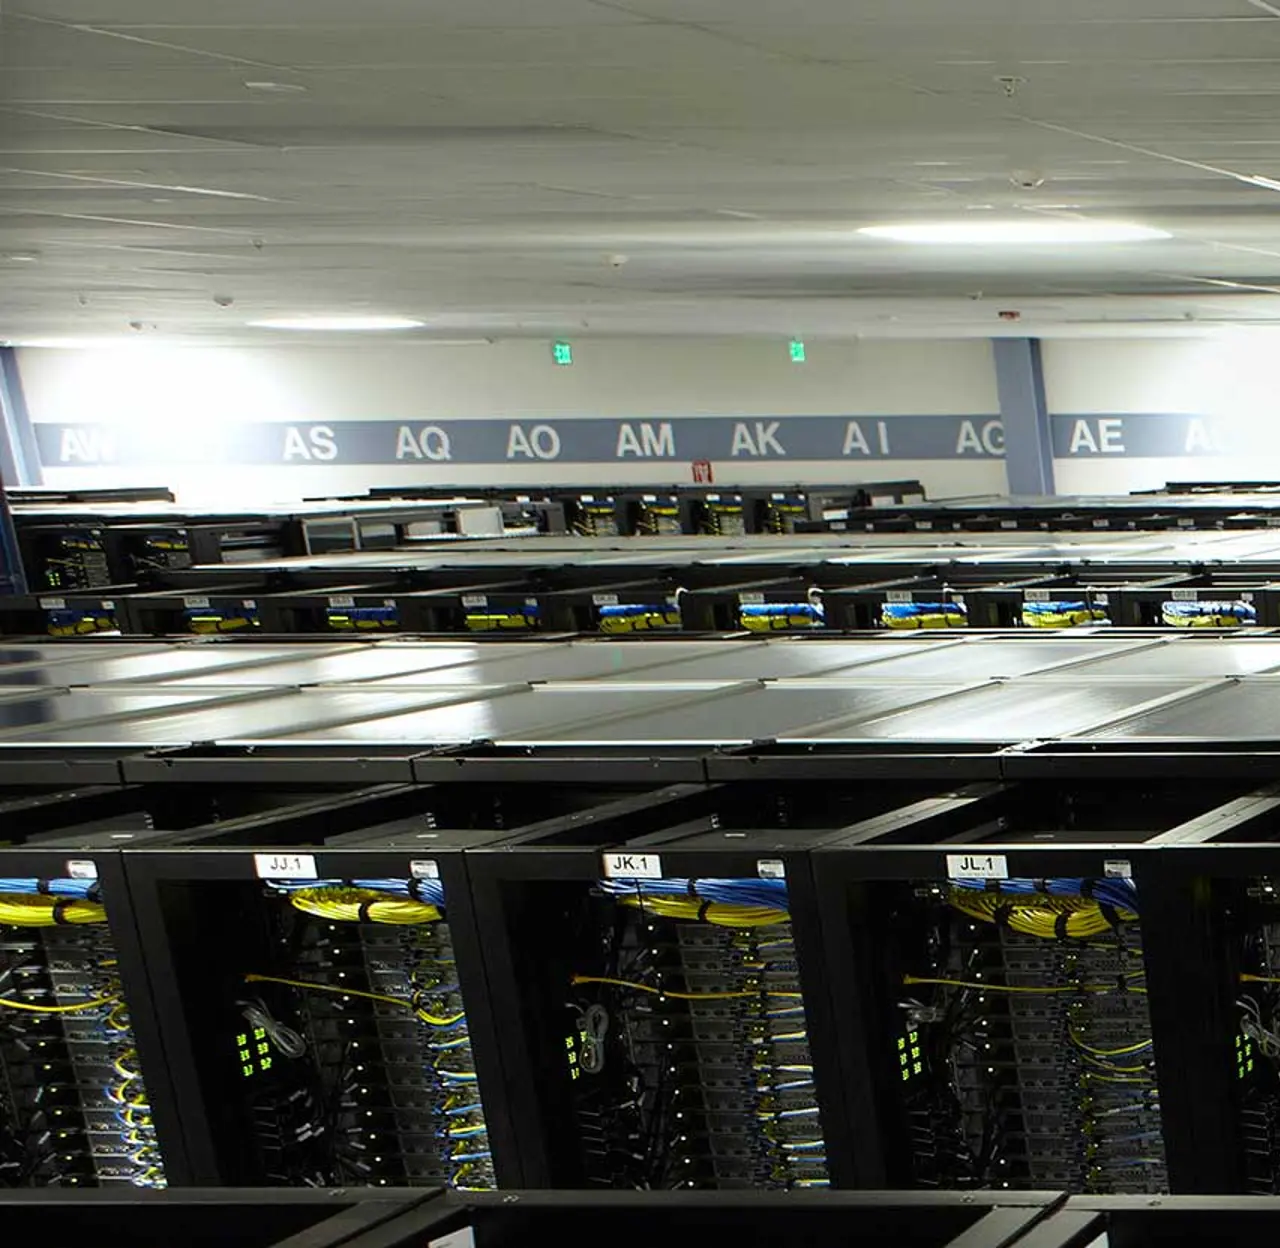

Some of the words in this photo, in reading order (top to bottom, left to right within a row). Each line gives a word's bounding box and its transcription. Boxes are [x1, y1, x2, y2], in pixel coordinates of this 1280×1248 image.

[283, 426, 338, 461] AS
[395, 425, 452, 461] AQ
[507, 424, 561, 460] AO
[616, 423, 676, 457] AM
[731, 421, 786, 456] AK
[842, 420, 889, 456] AI
[1069, 419, 1126, 453] AE
[270, 857, 302, 871] JJ.1
[613, 856, 648, 870] JK.1
[960, 857, 995, 871] JL.1
